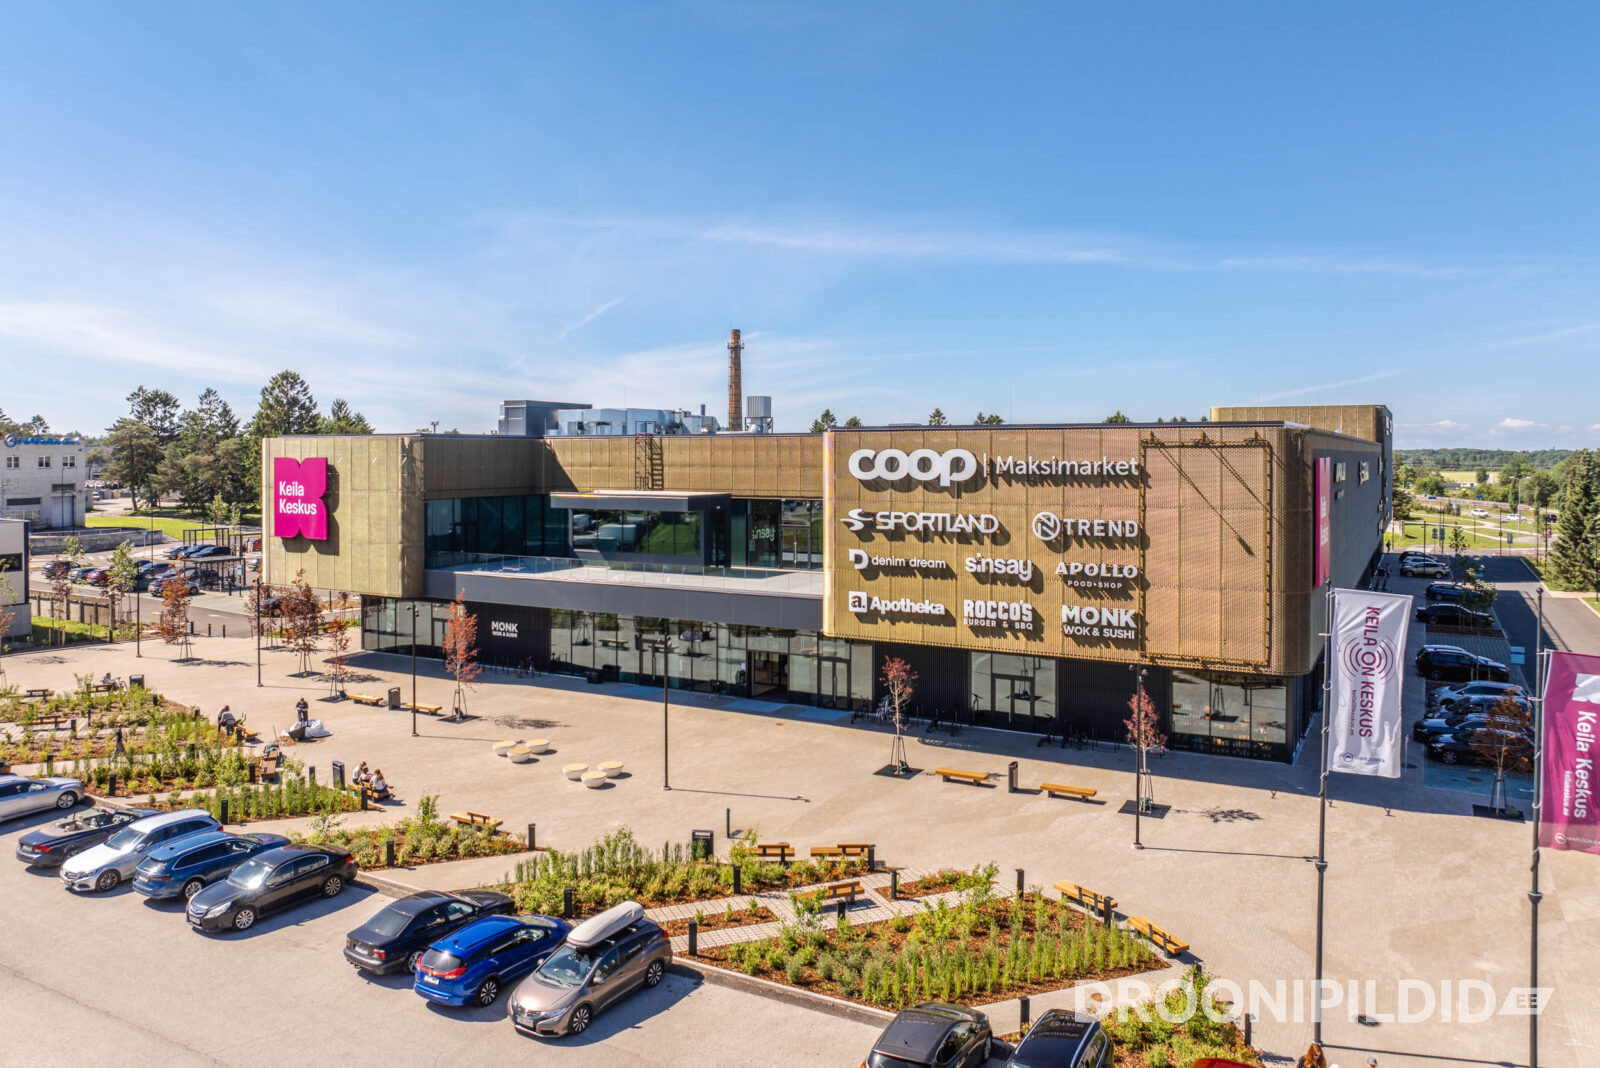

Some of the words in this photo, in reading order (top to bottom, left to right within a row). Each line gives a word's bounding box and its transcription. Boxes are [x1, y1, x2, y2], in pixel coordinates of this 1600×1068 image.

[996, 455, 1139, 476] Maksimarket
[279, 481, 305, 496] Keila
[279, 498, 317, 515] Keskus
[875, 511, 999, 534] SPORTLAND
[1063, 518, 1139, 538] TREND
[871, 555, 906, 566] denim
[909, 557, 947, 569] dream
[965, 552, 1032, 582] sinsay
[1055, 562, 1138, 579] APOLLO
[870, 596, 945, 615] Apotheka
[963, 599, 1033, 622] ROCCO'S
[1061, 604, 1138, 628] MONK
[491, 620, 519, 633] MONK
[963, 618, 997, 628] BURGER
[1002, 621, 1009, 629] &
[1014, 621, 1034, 631] BBQ
[1063, 625, 1091, 636] WOK
[1092, 627, 1100, 637] &
[1102, 628, 1135, 640] SUSHI
[1363, 606, 1381, 646] KEILA
[1360, 651, 1376, 677] ON
[1358, 680, 1375, 738] KESKUS
[1576, 710, 1597, 753] Keila
[1574, 757, 1593, 819] Keskus
